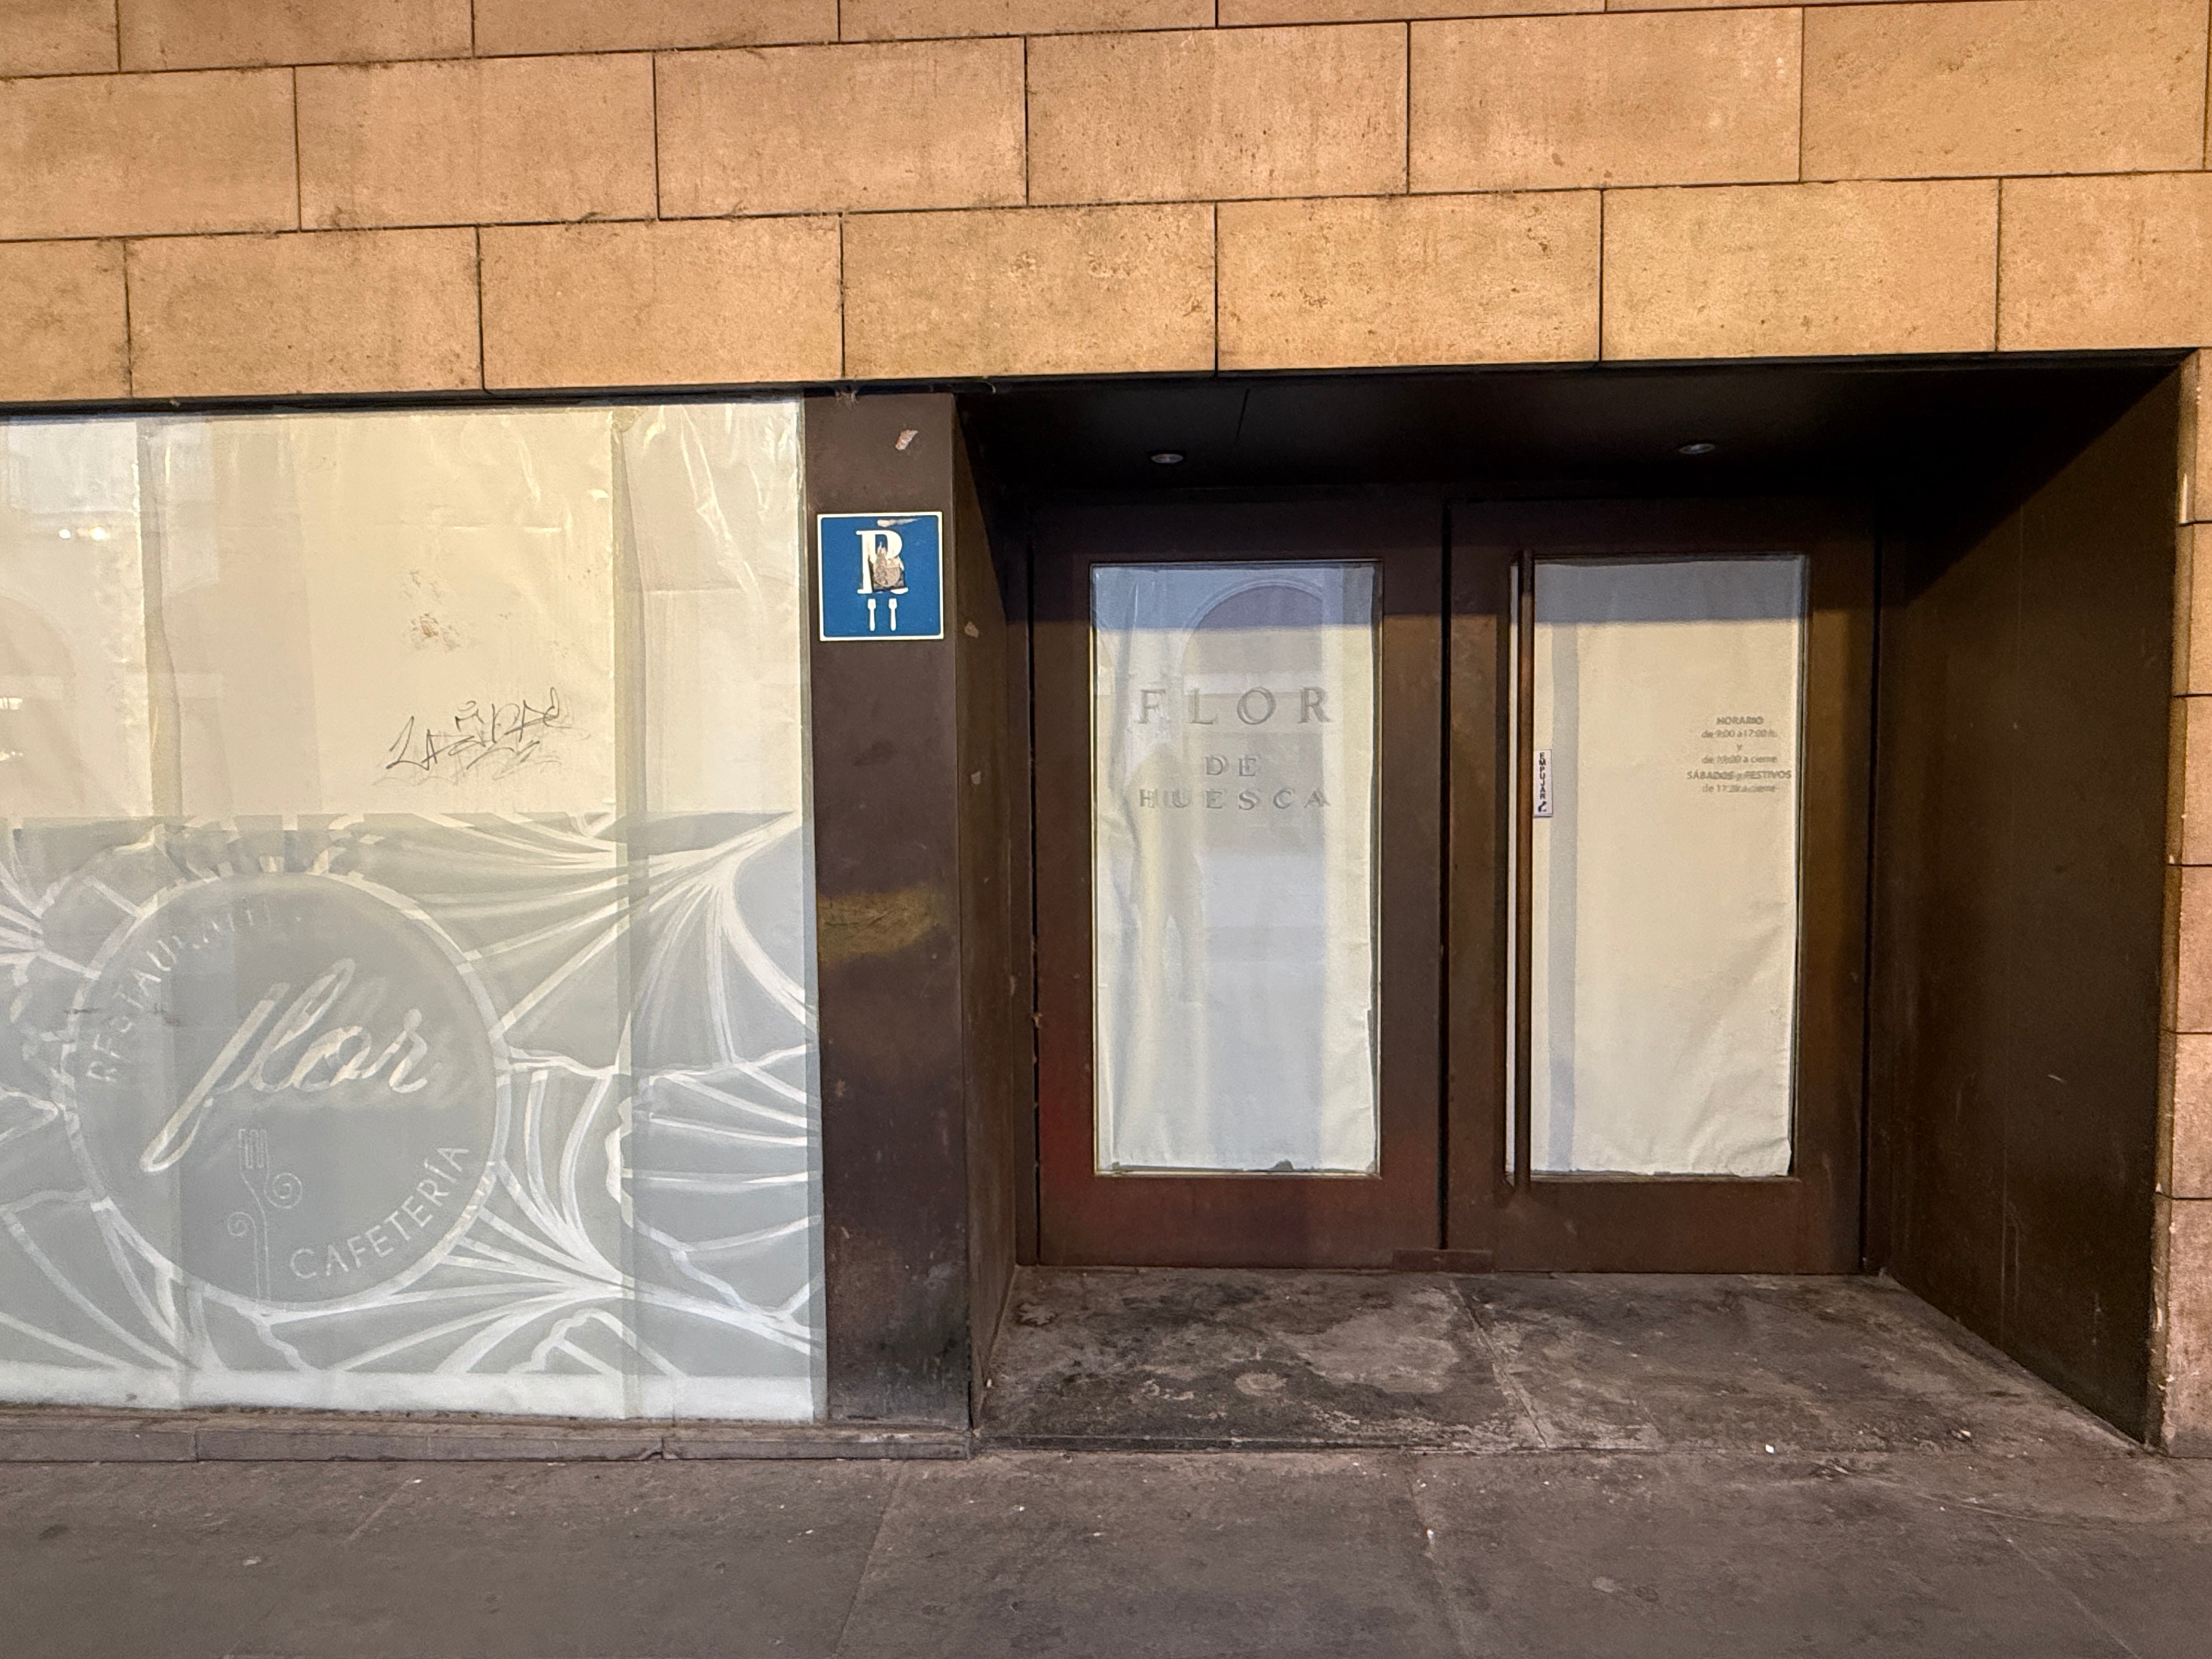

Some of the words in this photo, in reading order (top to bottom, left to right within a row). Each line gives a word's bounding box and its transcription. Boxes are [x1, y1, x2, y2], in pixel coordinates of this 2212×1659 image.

[855, 529, 909, 595] R
[1137, 686, 1333, 725] FLOR
[1716, 716, 1764, 725] HORARIO
[1702, 730, 1714, 738] de
[1736, 743, 1742, 752] y
[1702, 755, 1714, 764] de
[1204, 754, 1259, 777] DE
[1686, 770, 1734, 780] SÁBADOS
[1745, 770, 1792, 780] FESTIVOS
[1702, 783, 1714, 793] de
[1139, 787, 1331, 811] HUESCA
[289, 1145, 469, 1280] CAFETERÍA
